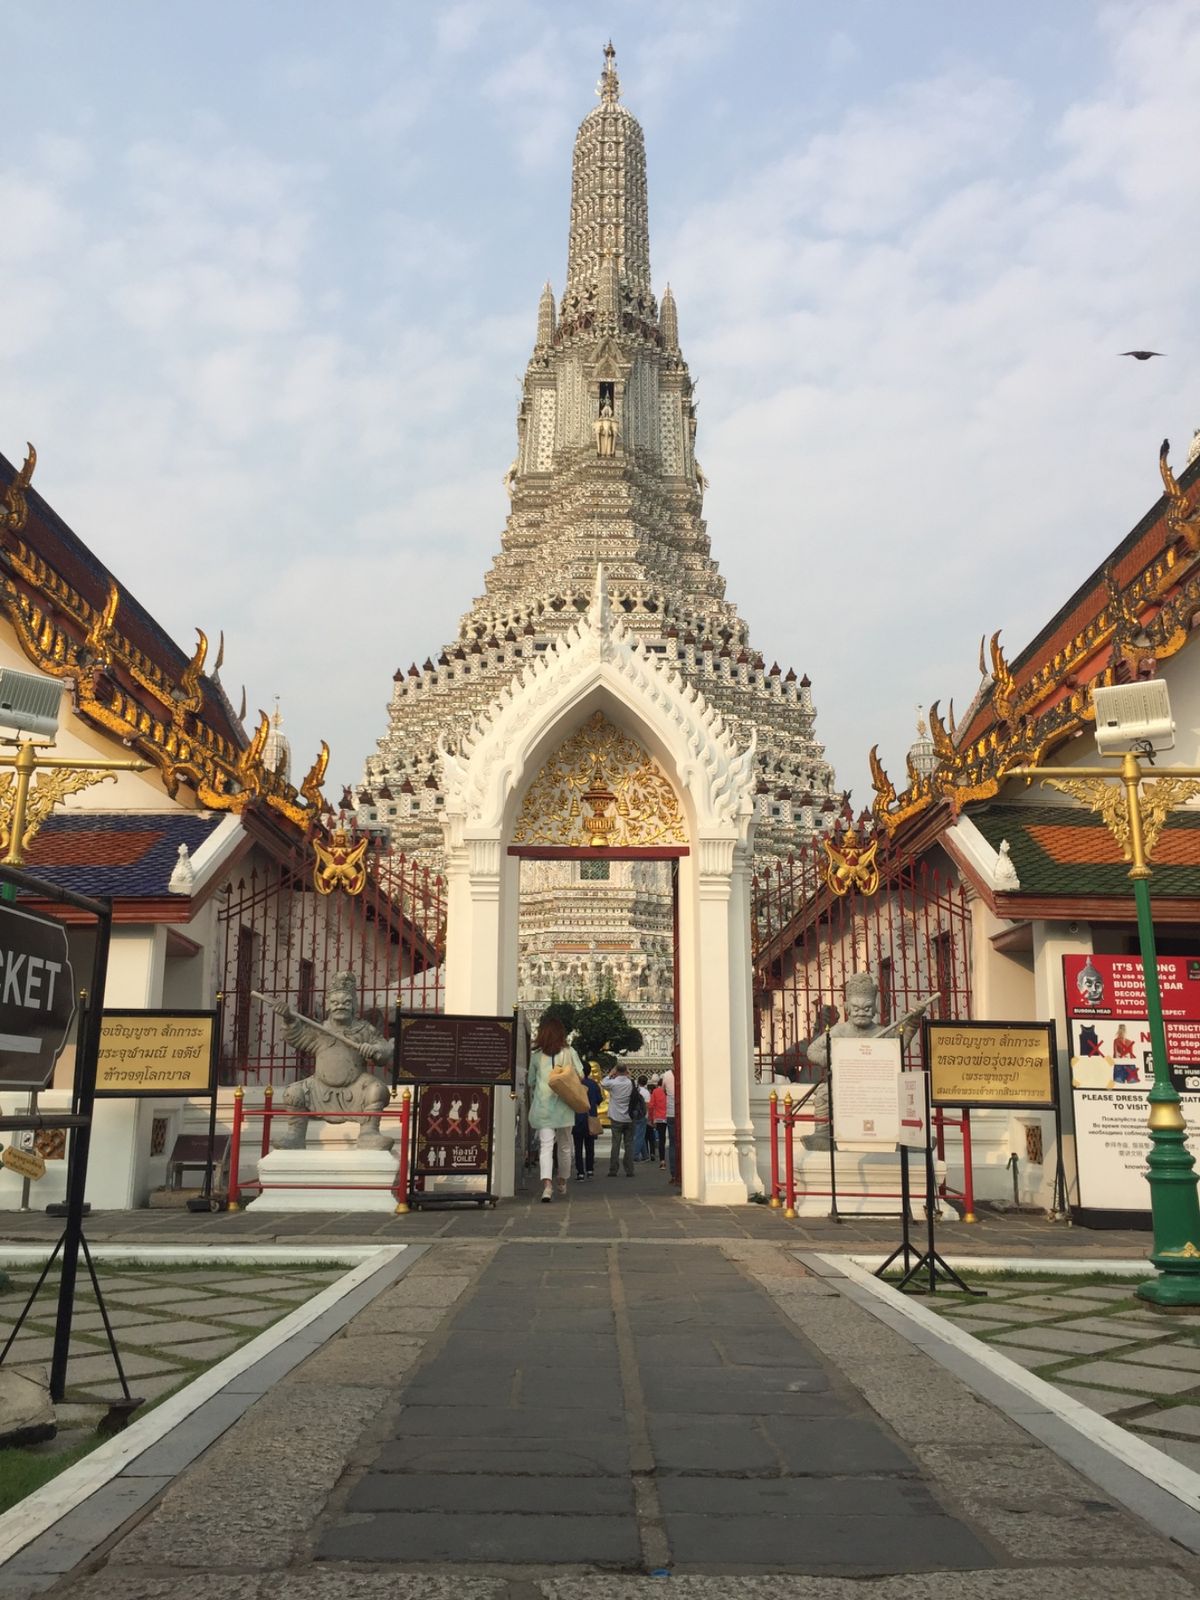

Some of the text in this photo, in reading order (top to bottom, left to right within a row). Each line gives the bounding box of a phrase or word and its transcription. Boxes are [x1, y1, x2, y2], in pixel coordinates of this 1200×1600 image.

[1112, 963, 1176, 972] IT'S WNG
[1114, 981, 1146, 989] BUDDH
[1164, 982, 1183, 990] BAR
[101, 1024, 158, 1040] อเชิญบูชา
[1167, 1024, 1200, 1032] STRICT
[1140, 1032, 1151, 1043] N
[452, 1145, 478, 1156] ห้องน้ำ
